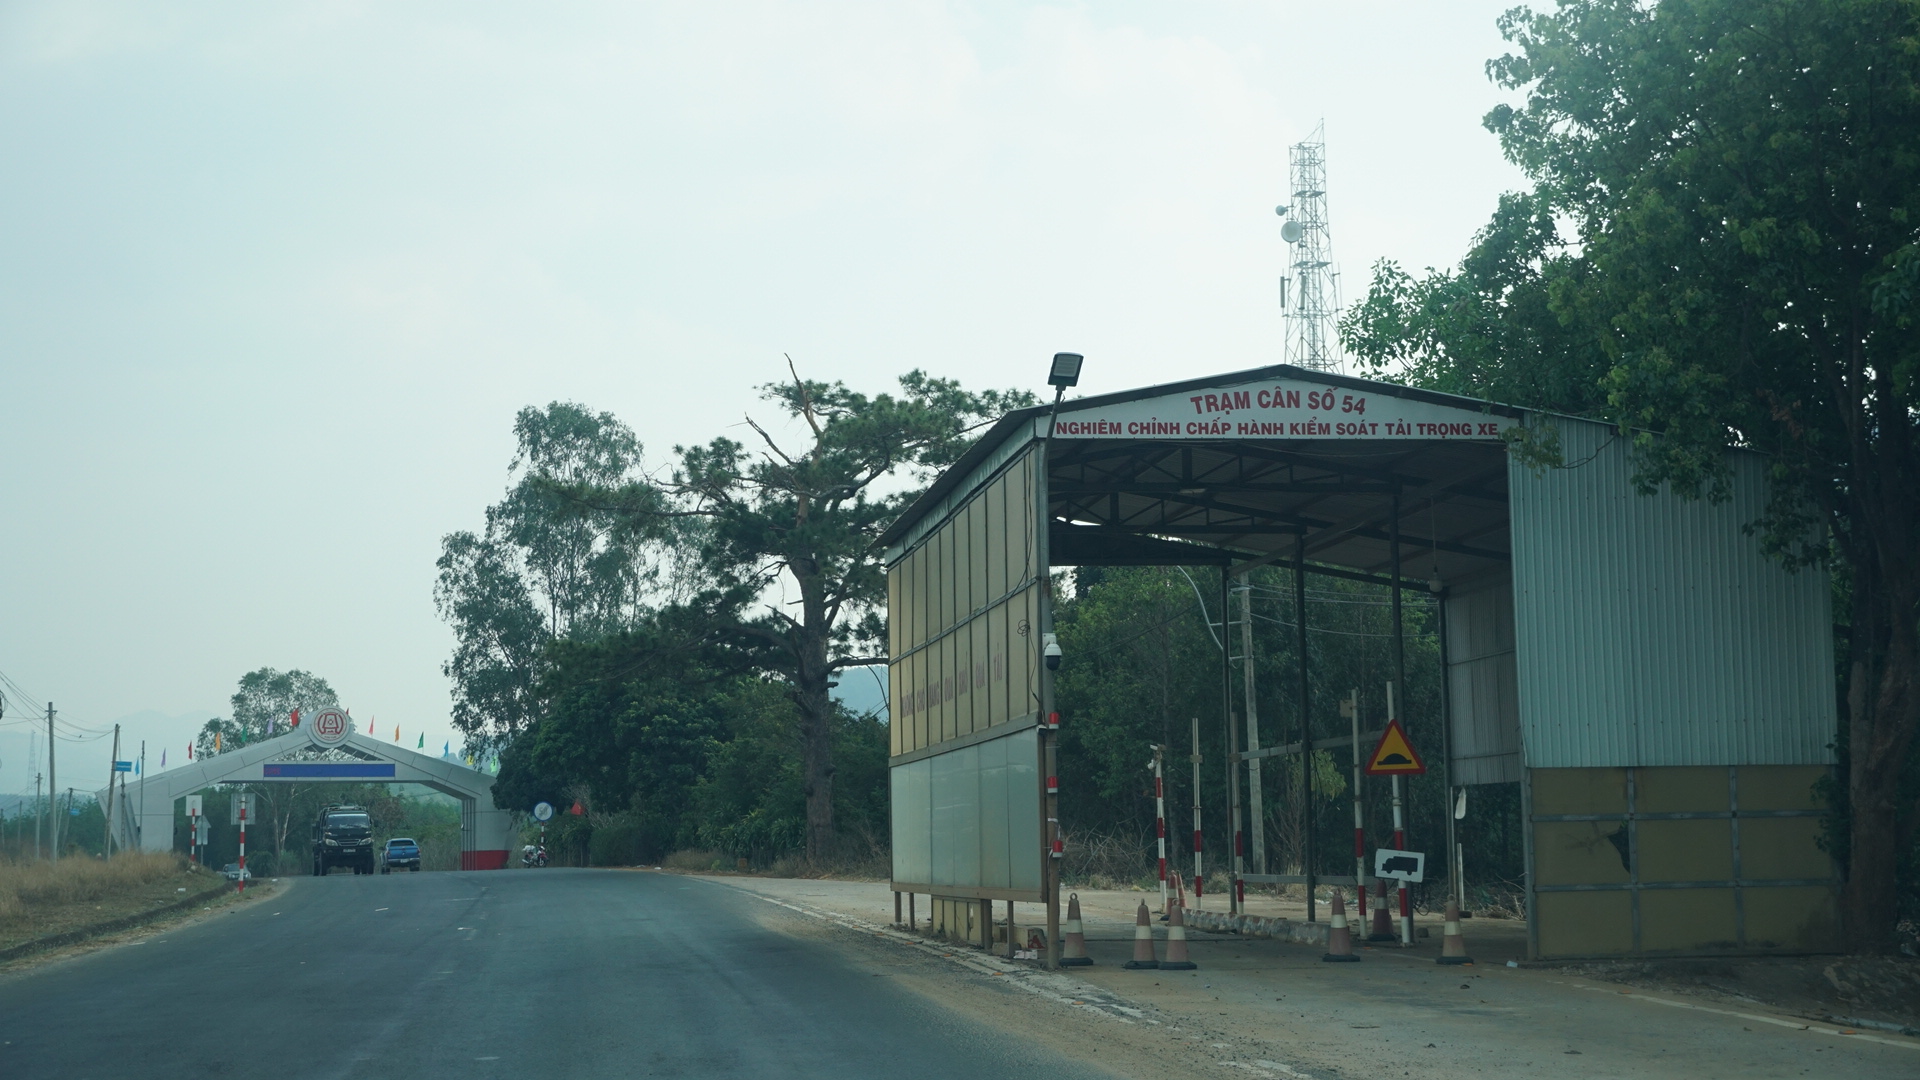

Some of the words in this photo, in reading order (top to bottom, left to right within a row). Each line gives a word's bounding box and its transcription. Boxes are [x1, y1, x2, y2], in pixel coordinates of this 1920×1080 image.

[1190, 390, 1251, 415] TRẠM
[1257, 386, 1300, 409] CÂN
[1307, 386, 1338, 411] SỐ
[1341, 395, 1366, 415] 54
[1056, 419, 1122, 435] NGHIÊM
[1128, 417, 1181, 435] CHỈNH
[1186, 416, 1232, 435] CHẤP
[1237, 419, 1284, 435] HÀNH
[1289, 416, 1331, 436] KIỂM
[1335, 419, 1378, 436] SOÁT
[1385, 418, 1412, 436] TẢI
[1417, 423, 1472, 439] TRỌNG
[1477, 423, 1498, 436] XE
